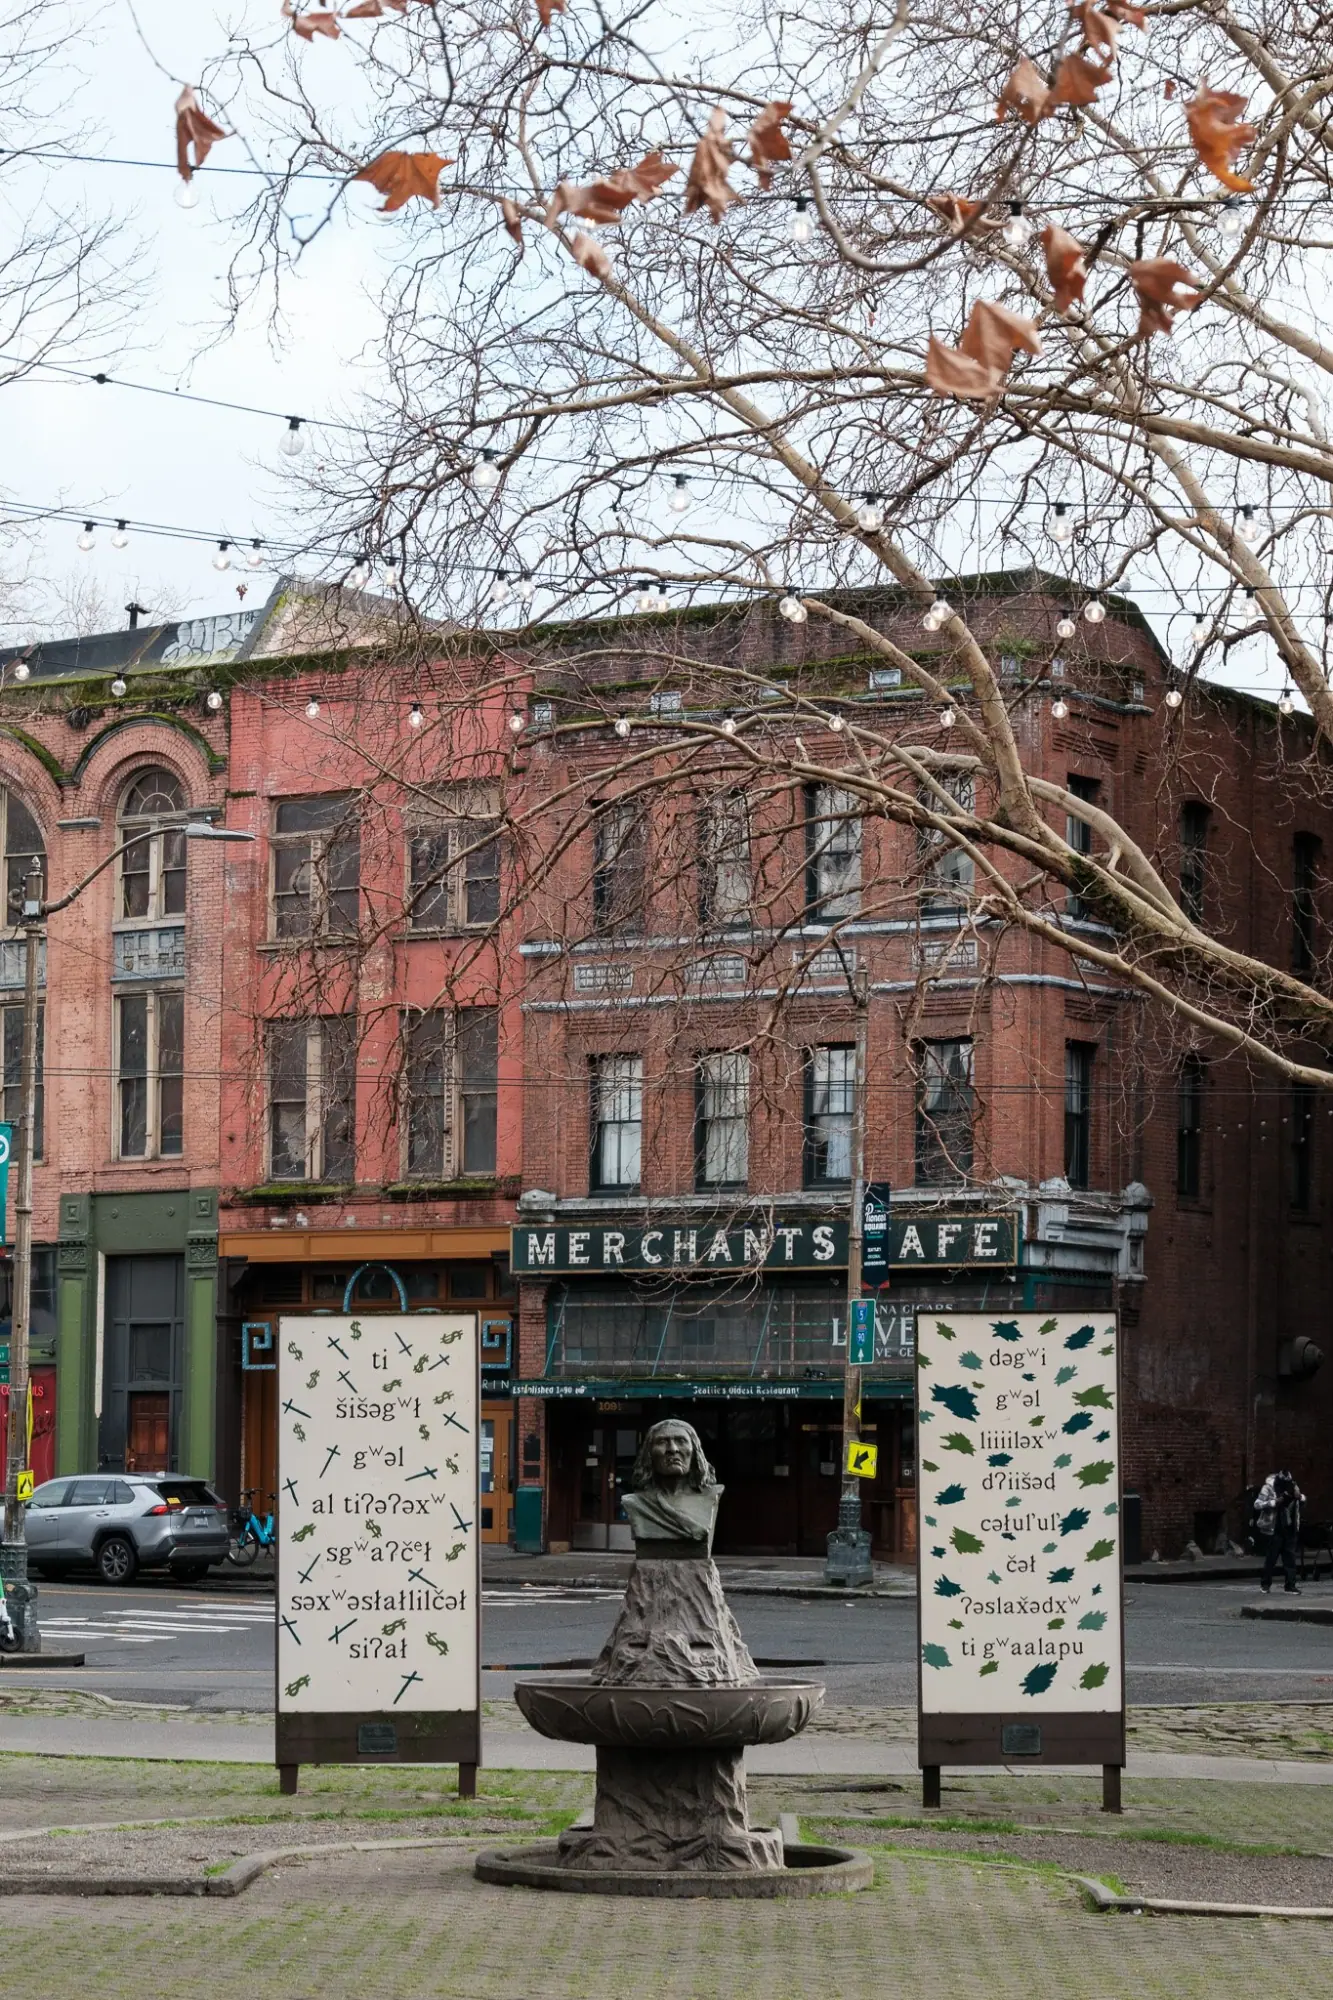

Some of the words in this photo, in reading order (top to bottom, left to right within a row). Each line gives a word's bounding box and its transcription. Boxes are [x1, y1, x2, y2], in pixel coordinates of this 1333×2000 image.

[528, 1226, 835, 1265] MERCHANTS
[899, 1223, 998, 1258] AFE
[859, 1310, 864, 1321] 5
[857, 1332, 866, 1343] 90
[372, 1349, 389, 1369] ti
[312, 1493, 334, 1514] al
[961, 1638, 975, 1656] ti
